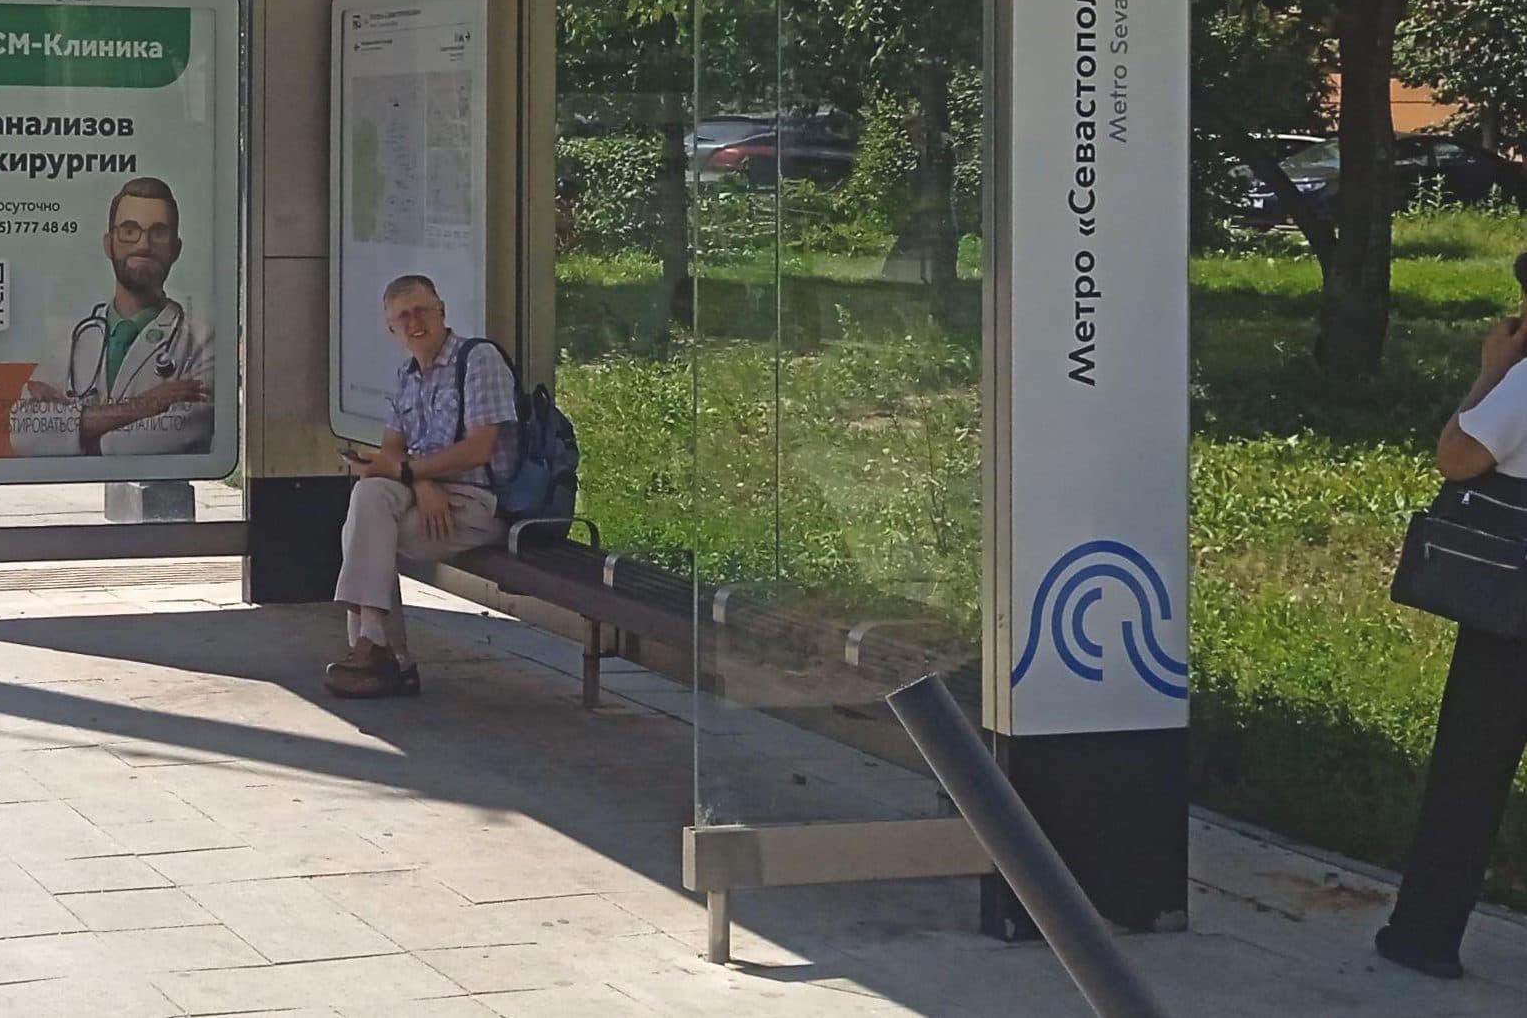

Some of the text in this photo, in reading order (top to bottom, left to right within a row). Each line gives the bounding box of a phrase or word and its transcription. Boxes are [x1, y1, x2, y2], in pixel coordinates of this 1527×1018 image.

[1109, 65, 1129, 144] Metro
[14, 222, 39, 233] 777
[41, 222, 58, 233] 48
[60, 222, 78, 233] 49
[1068, 250, 1101, 387] Метро
